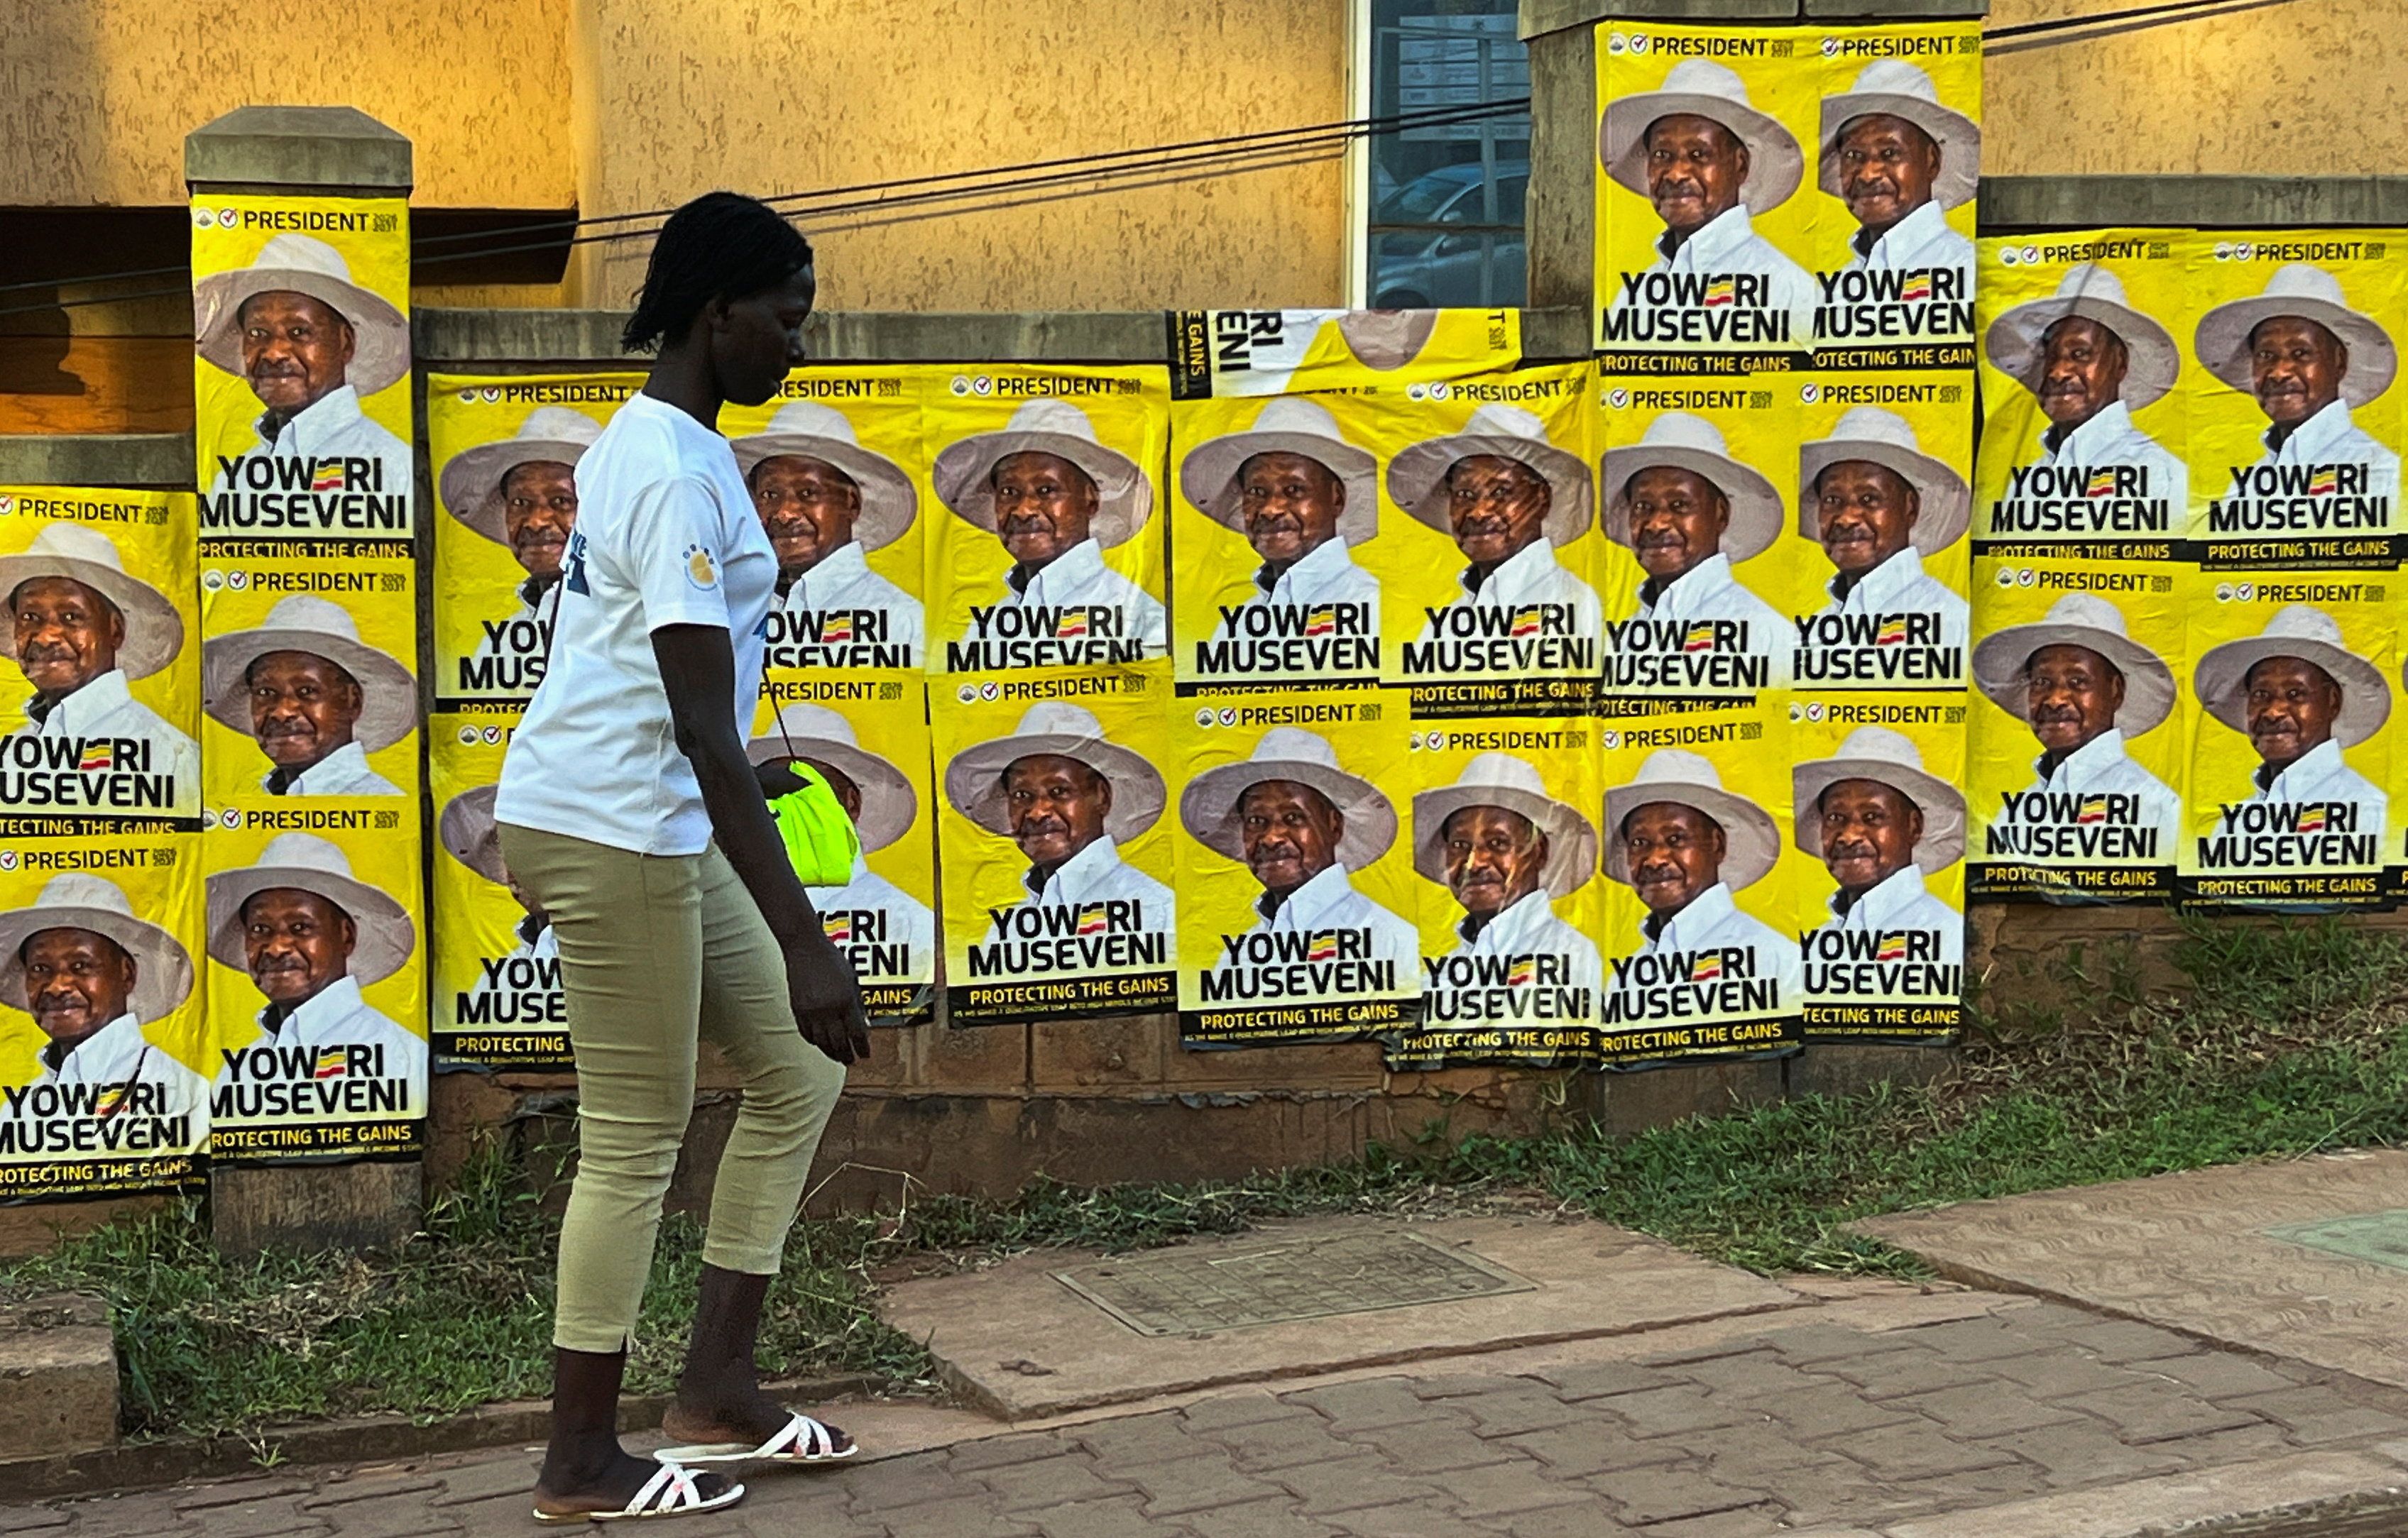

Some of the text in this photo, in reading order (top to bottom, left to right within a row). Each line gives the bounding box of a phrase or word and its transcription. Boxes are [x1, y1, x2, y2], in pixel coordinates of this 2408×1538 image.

[1653, 38, 1768, 57] PRESIDENT
[1844, 37, 1955, 57] PRESIDENT
[244, 211, 368, 231] PRESIDENT
[2044, 239, 2145, 262] PRESIDENT
[2255, 243, 2360, 261] PRESIDENT
[1621, 273, 1768, 307] YOWERI
[1816, 267, 1964, 303] YOWERI
[1603, 310, 1789, 342] MUSEVENI
[1602, 356, 1790, 373] ROTECTING THE GAINS
[1815, 348, 1974, 368] OTECTING THE GAIN
[506, 385, 629, 403] PRESIDENT
[998, 379, 1114, 395] PRESIDENT
[1453, 380, 1562, 400] PRESIDENT
[1823, 385, 1936, 404] PRESIDENT
[1633, 392, 1746, 409] PRESIDENT
[218, 456, 381, 492] YOWERI
[2011, 466, 2147, 498] YOWERI
[2231, 463, 2368, 497] YOWERI
[19, 500, 142, 522] PRESIDENT
[199, 494, 405, 529] MUSEVENI
[1990, 500, 2168, 532] MUSEVENI
[2209, 497, 2387, 532] MUSEVENI
[312, 542, 349, 558] THE
[354, 544, 409, 559] GAINS
[2086, 544, 2118, 558] THE
[2123, 544, 2169, 558] GAINS
[2209, 541, 2389, 559] PROTECTING THE GAINS
[253, 573, 376, 591] PRESIDENT
[2039, 570, 2147, 592] PRESIDENT
[2258, 585, 2361, 602] PRESIDENT
[765, 610, 887, 643] OWERI
[970, 606, 1122, 639] YOWERI
[1219, 604, 1369, 637] YOWERI
[1425, 604, 1575, 639] YOWERI
[1795, 613, 1940, 645] YOWERI
[1607, 621, 1748, 652] YOWERI
[1197, 639, 1379, 674] MUSEVEN
[1403, 638, 1593, 674] MUSEVENI
[759, 682, 875, 700] PRESIDENT
[1004, 677, 1118, 700] PRESIDENT
[1411, 681, 1594, 702] ROTECTING THE GAINS
[1241, 705, 1353, 725] PRESIDENT
[1829, 705, 1942, 723] PRESIDENT
[1450, 732, 1563, 749] PRESIDENT
[1624, 723, 1736, 748] PRESIDENT
[0, 773, 174, 807] USEVENI
[248, 810, 370, 829] PRESIDENT
[2001, 793, 2138, 824] YOWERI
[2221, 802, 2357, 833] YOWERI
[0, 818, 175, 835] TECTING THE GAINS
[1987, 827, 2157, 858] MUSEVENI
[2198, 835, 2376, 868] MUSEVENI
[24, 850, 148, 869] PRESIDENT
[2075, 870, 2105, 885] THE
[2110, 871, 2157, 886] GAINS
[2199, 879, 2376, 895] PROTECTING THE GAINS
[988, 901, 1141, 940] YOWERI
[969, 934, 1164, 977] MUSEVENI
[1222, 929, 1372, 965] YOWERI
[1200, 960, 1394, 1001] MUSEVENI
[1425, 955, 1570, 990] YOWERI
[1611, 947, 1755, 989] YOWERI
[1805, 964, 1960, 995] USEVENI
[970, 979, 1169, 1005] PROTECTING THE GAINS
[457, 993, 566, 1023] MUSE
[1201, 1005, 1399, 1030] PROTECTING THE GAINS
[1803, 1009, 1960, 1026] TECTING THE GAINS
[456, 1037, 564, 1052] PROTECTING
[1506, 1033, 1540, 1047] THE
[1544, 1031, 1589, 1046] GAINS
[1600, 1031, 1690, 1051] ROTECTING
[1695, 1028, 1729, 1043] THE
[1732, 1024, 1781, 1040] GAINS
[223, 1044, 383, 1082] YOWERI
[4, 1082, 165, 1120] YOWERI
[210, 1080, 407, 1119] MUSEVENI
[211, 1125, 411, 1148] ROTECTING THE GAINS
[0, 1160, 192, 1184] ROTECTING THE GAINS
